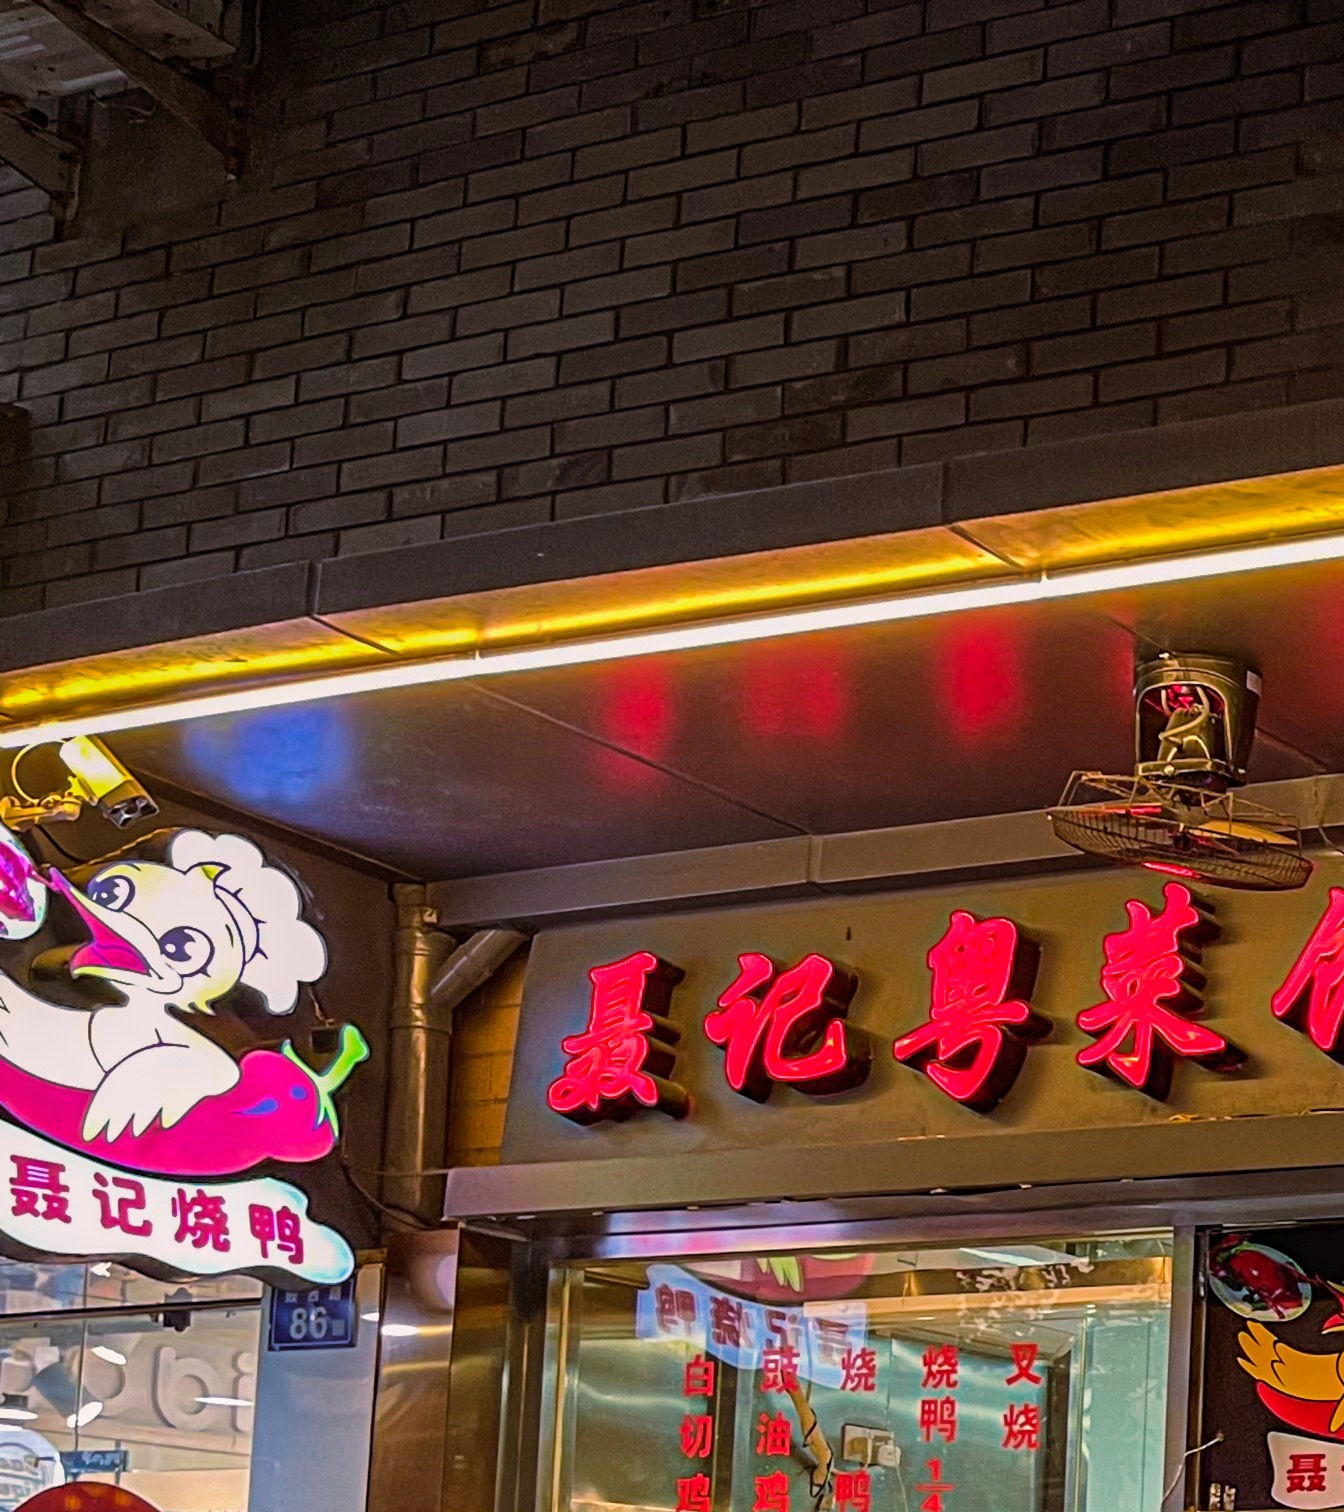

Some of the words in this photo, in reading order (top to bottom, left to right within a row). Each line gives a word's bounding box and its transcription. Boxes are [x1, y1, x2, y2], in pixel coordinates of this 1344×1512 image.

[9, 1154, 302, 1264] 聂记烧鸭
[289, 1307, 328, 1340] 86
[919, 1344, 960, 1444] 烧鸭
[1001, 1342, 1043, 1451] 叉烧
